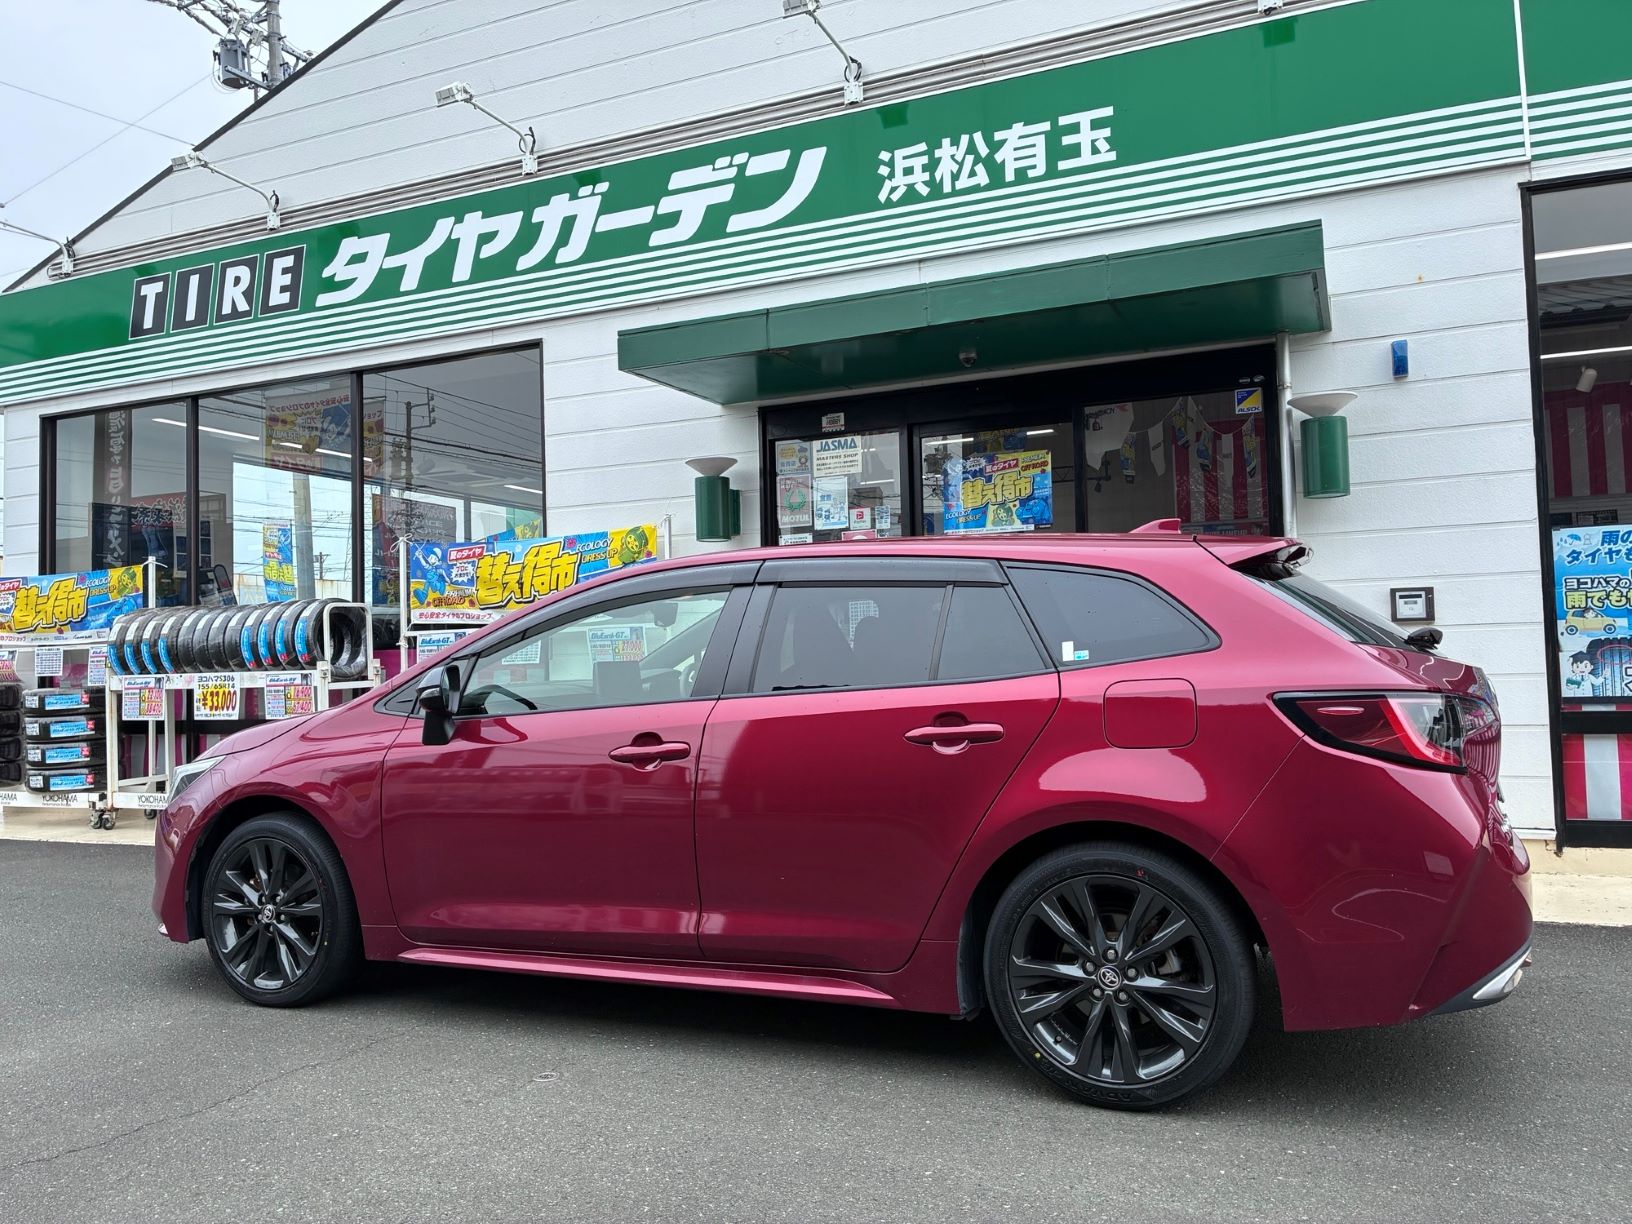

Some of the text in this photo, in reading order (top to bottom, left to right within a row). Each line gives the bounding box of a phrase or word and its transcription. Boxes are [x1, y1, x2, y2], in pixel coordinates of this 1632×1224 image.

[140, 106, 1118, 330] TIRE タイヤガーデン 浜松有玉
[816, 438, 857, 453] JASMA
[962, 472, 1032, 509] 替え得市
[782, 514, 809, 523] MOTUL
[577, 538, 613, 552] ECOLOGY
[450, 548, 482, 560] 夏のタイヤ
[581, 551, 606, 564] DRESS
[86, 575, 112, 587] ECOLOGY
[476, 541, 579, 607] 替え得市
[1565, 577, 1631, 590] ヨコハマの
[13, 579, 87, 631] 替え得市
[1565, 589, 1632, 610] 雨でも
[198, 675, 235, 683] ヨコハマS306
[202, 690, 237, 711] ¥33,000
[42, 794, 78, 803] YOKOHAMA
